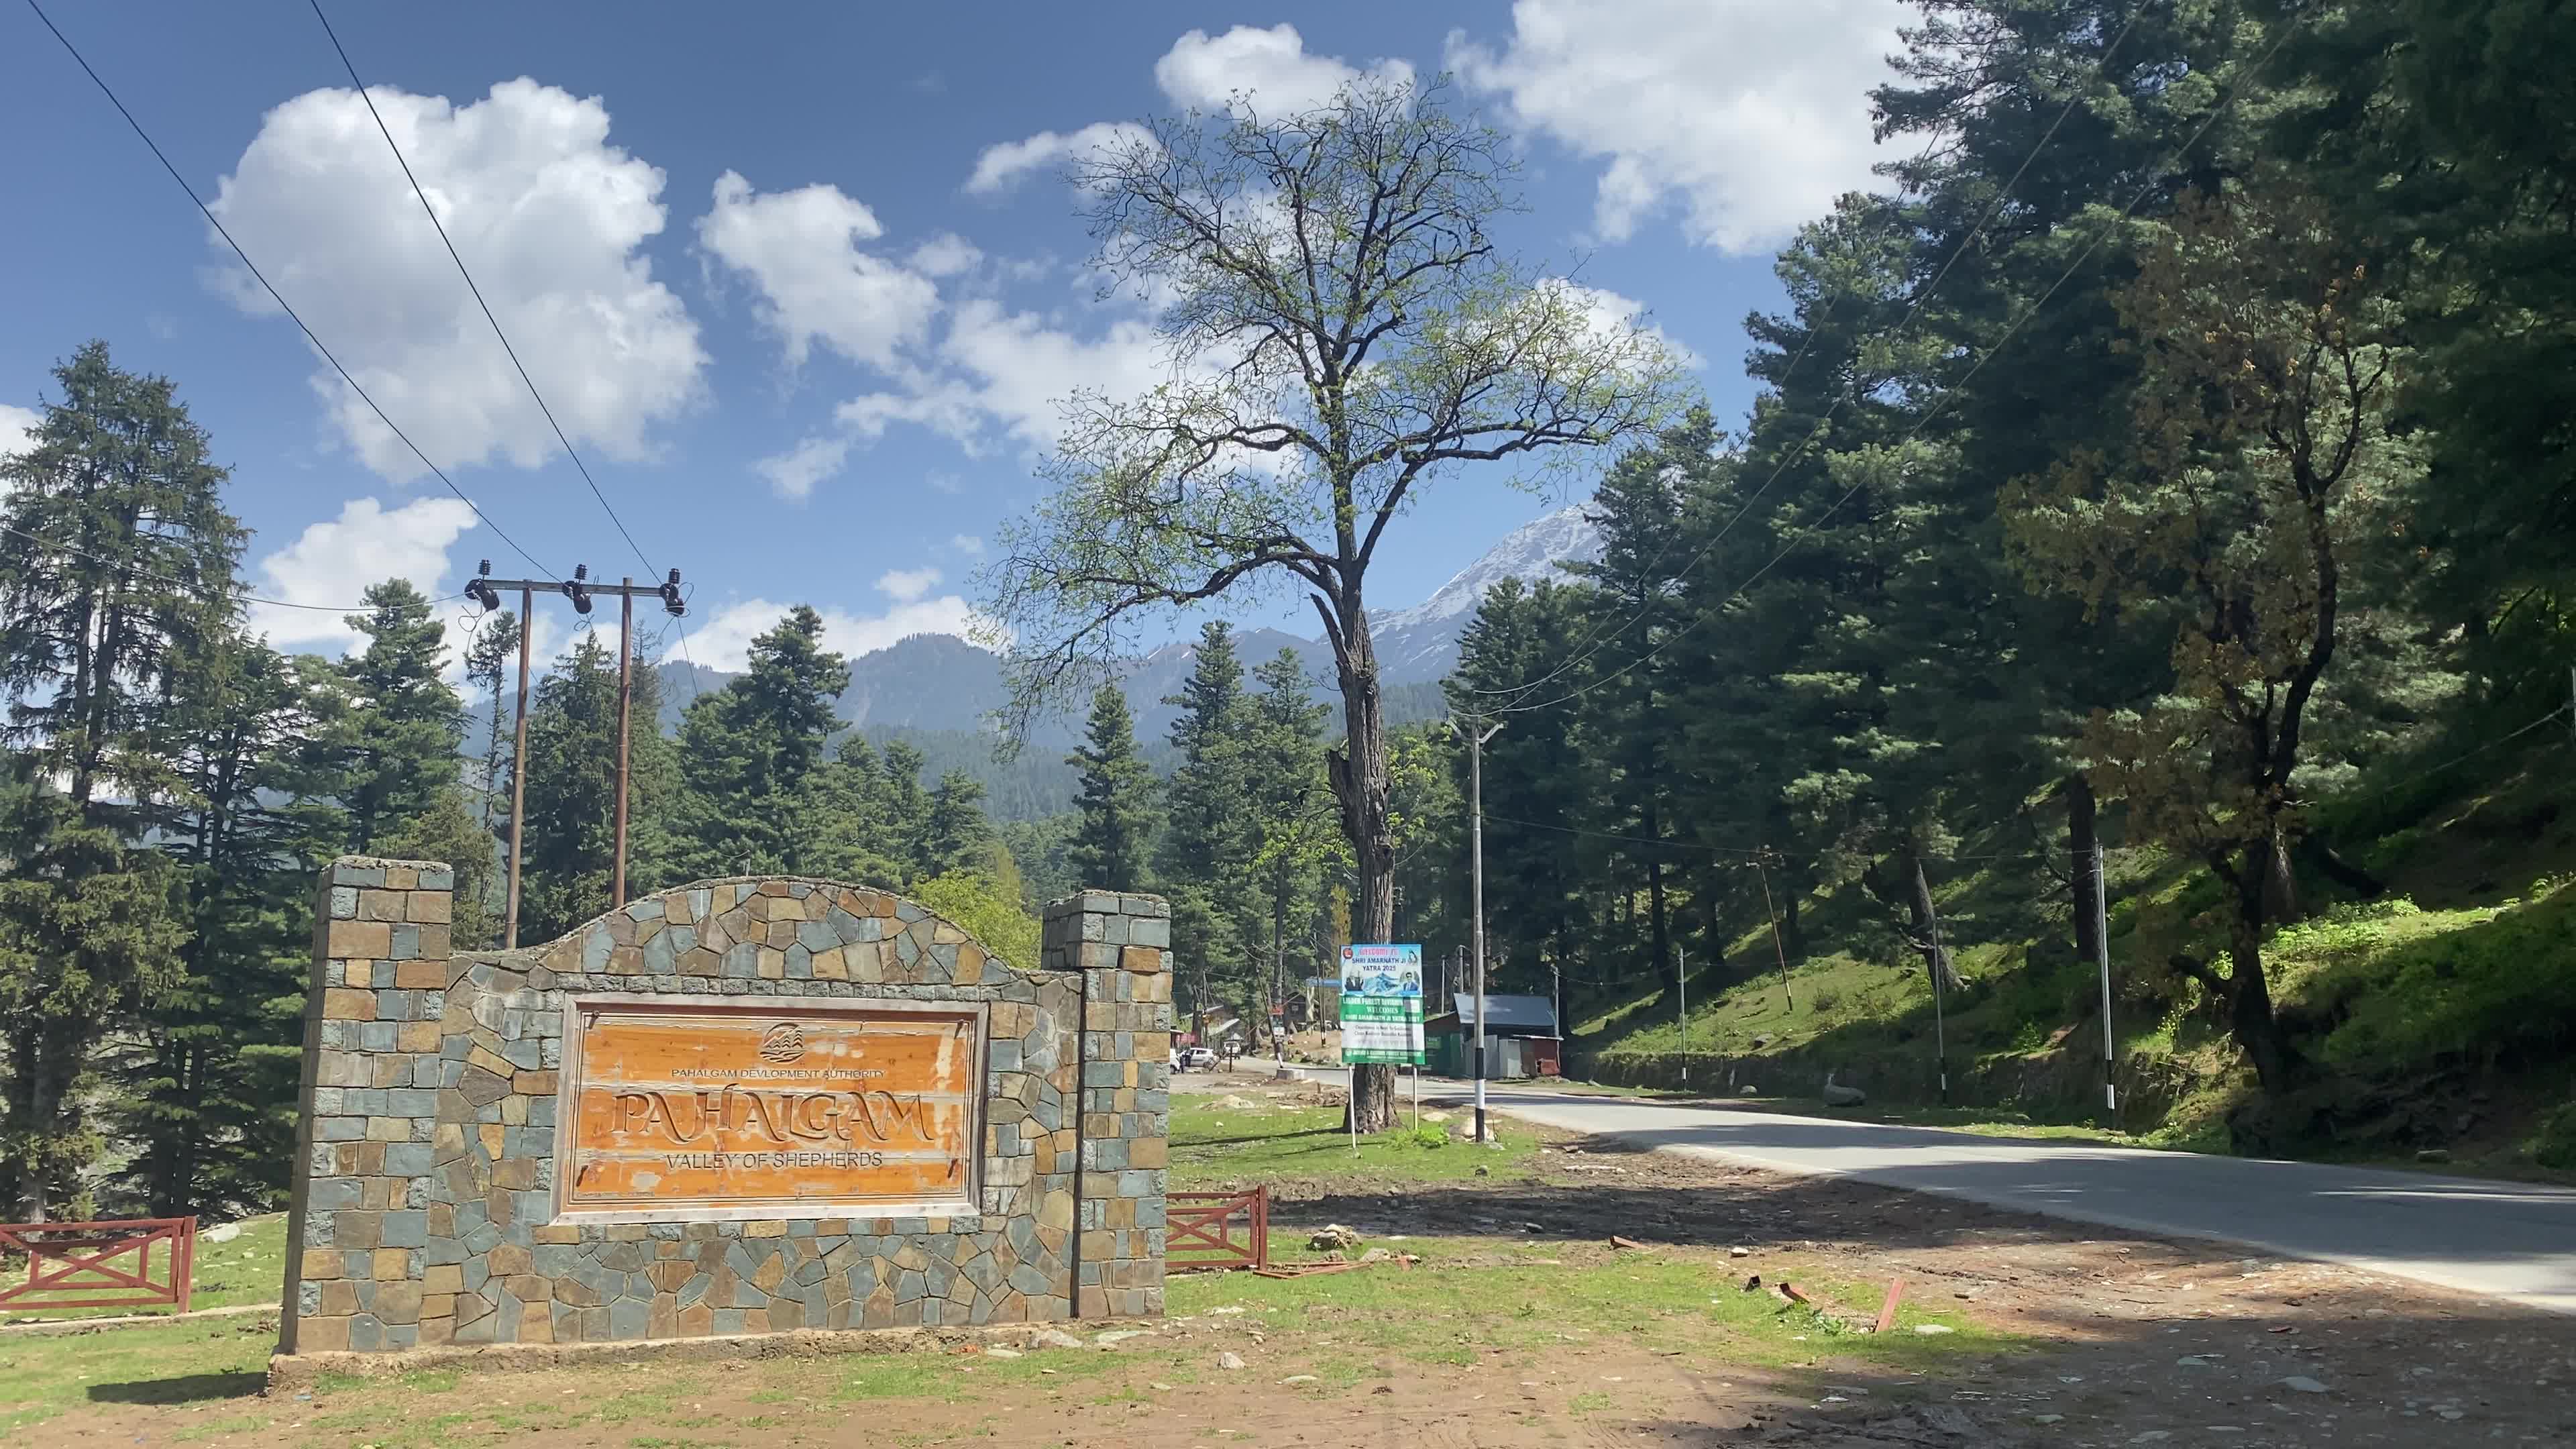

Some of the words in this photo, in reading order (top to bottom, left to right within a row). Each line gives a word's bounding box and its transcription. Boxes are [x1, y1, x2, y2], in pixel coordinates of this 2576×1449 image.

[672, 1069, 737, 1078] PAHALGAM
[741, 1069, 820, 1078] DEVLOPMENT
[822, 1069, 885, 1079] AUTHORITY
[610, 1083, 934, 1142] PAHALGAM
[665, 1153, 737, 1169] VALLEY
[743, 1153, 769, 1168] OF
[772, 1152, 883, 1169] SHEPHERDS
